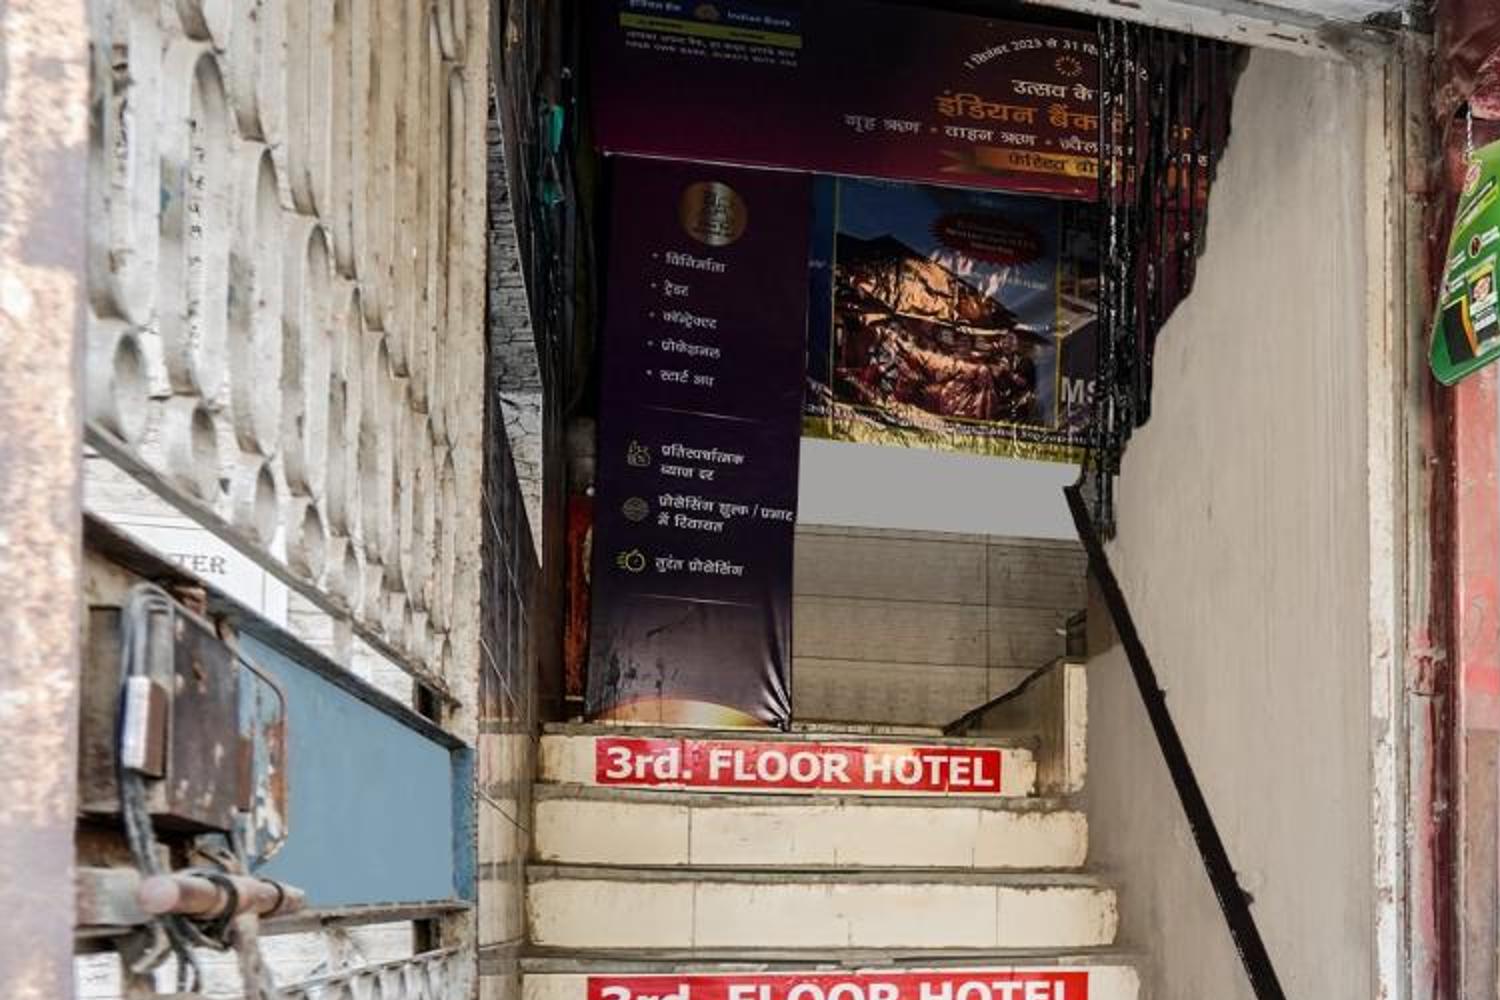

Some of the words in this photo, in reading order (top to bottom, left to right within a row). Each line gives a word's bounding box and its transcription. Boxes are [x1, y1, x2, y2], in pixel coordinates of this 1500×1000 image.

[1010, 39, 1043, 52] 2023
[1012, 79, 1069, 99] उत्सव
[938, 88, 1038, 125] इंडियन
[1048, 102, 1099, 131] बैंक
[605, 746, 692, 780] 3rd.
[709, 749, 852, 784] FLOOR
[864, 753, 994, 788] HOTEL
